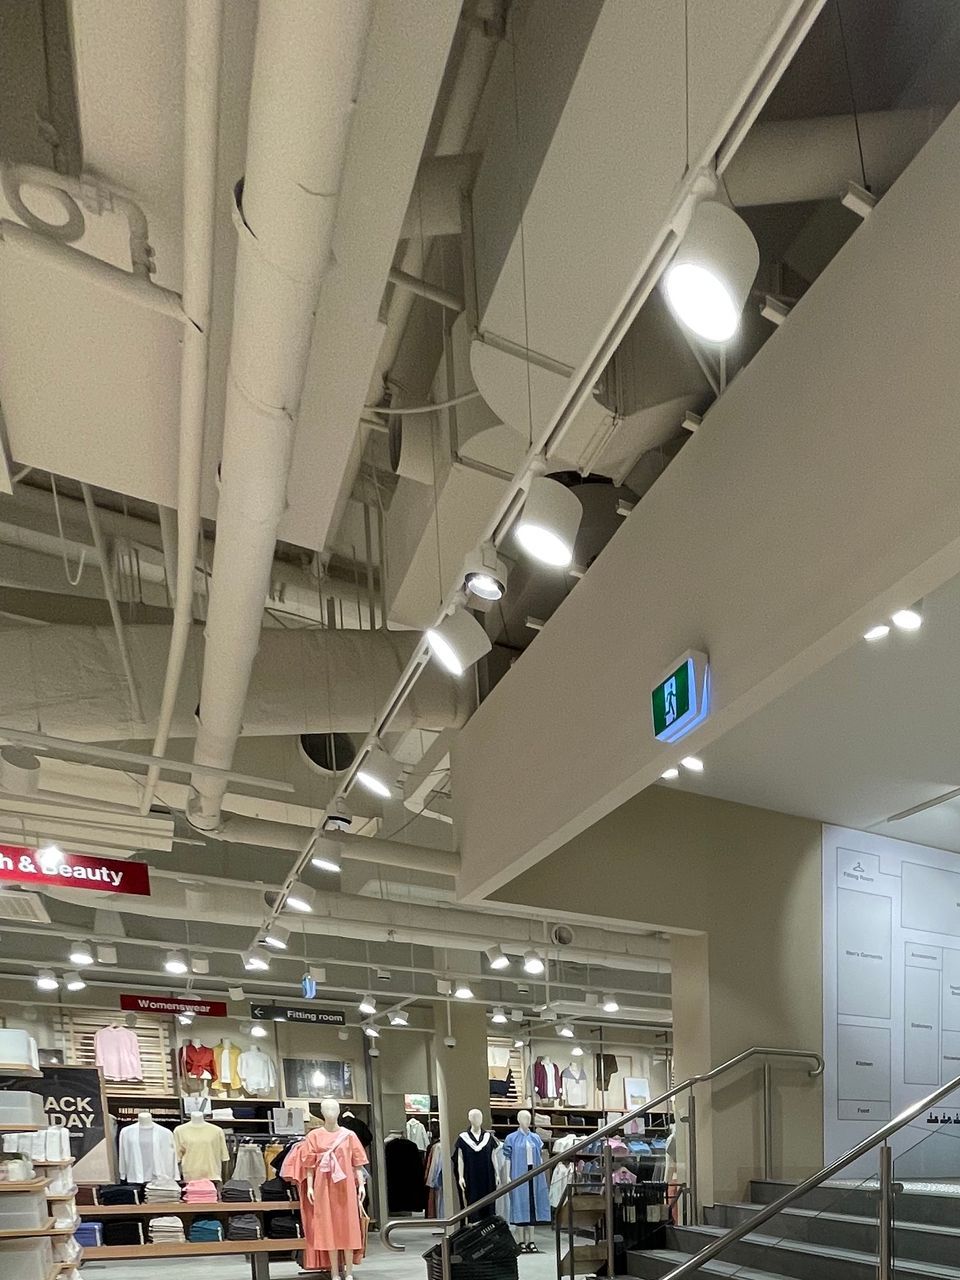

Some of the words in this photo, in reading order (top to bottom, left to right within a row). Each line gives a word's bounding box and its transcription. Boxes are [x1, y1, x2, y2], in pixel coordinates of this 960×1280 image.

[18, 855, 38, 874] &
[138, 998, 211, 1014] Womenswear
[287, 1010, 317, 1022] Fitting
[318, 1013, 343, 1022] room
[44, 1096, 94, 1112] ACK
[50, 1113, 95, 1128] DAY
